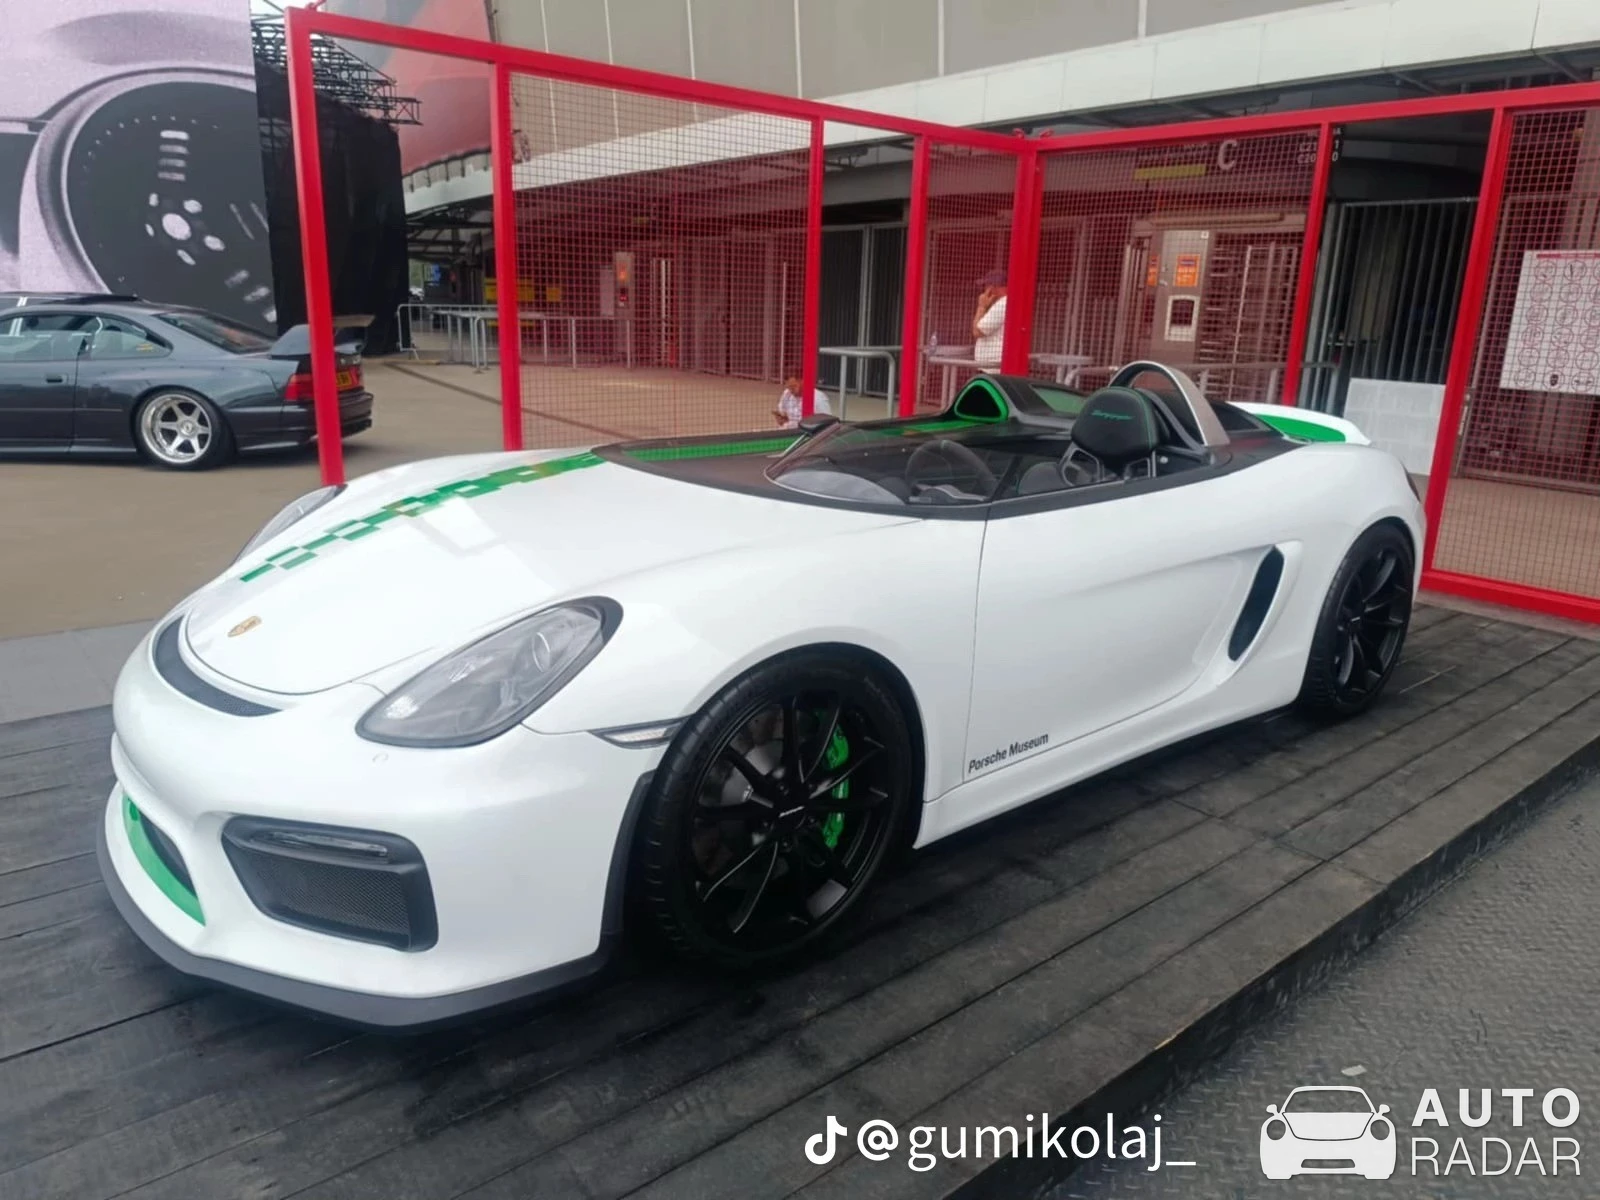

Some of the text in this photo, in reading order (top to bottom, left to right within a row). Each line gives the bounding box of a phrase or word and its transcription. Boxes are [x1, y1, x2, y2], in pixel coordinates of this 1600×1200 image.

[1219, 139, 1238, 170] C
[968, 733, 1049, 774] Porsche Museum
